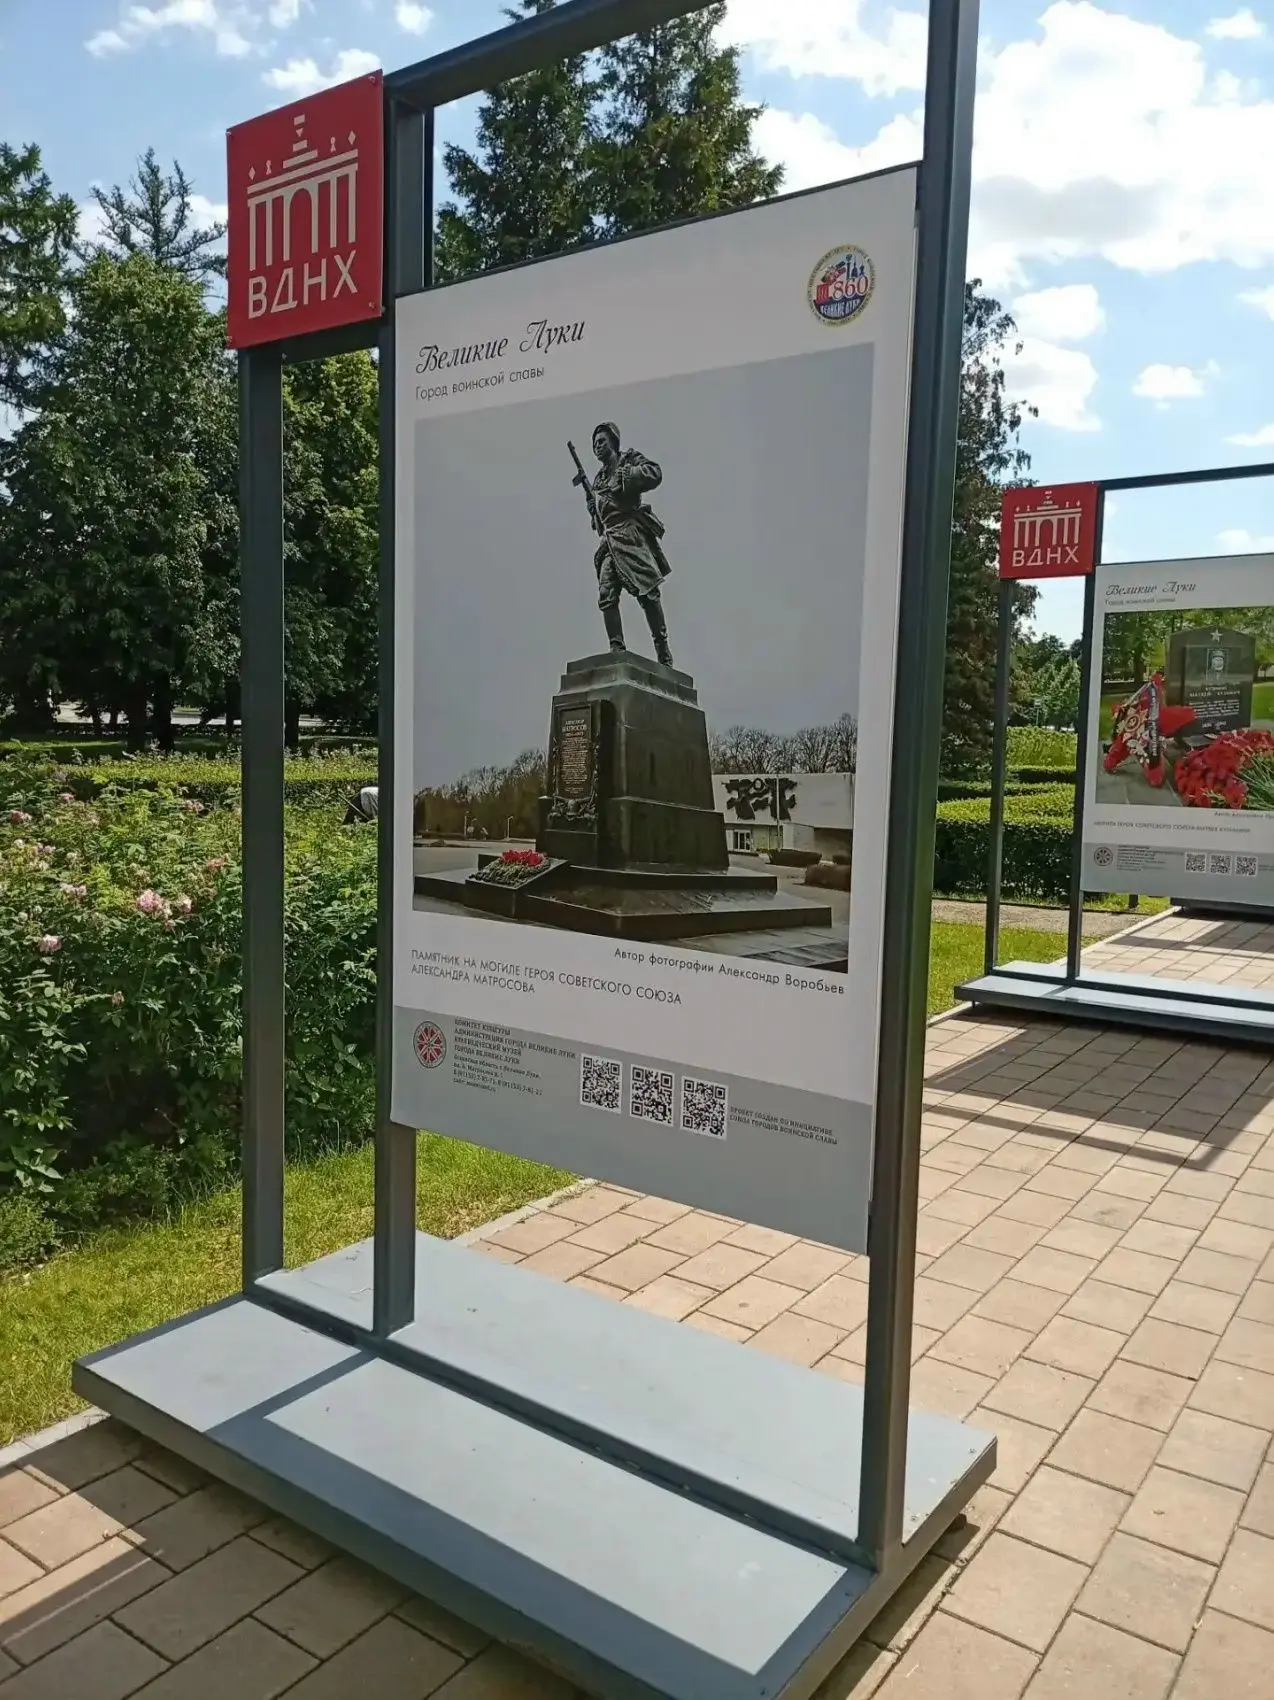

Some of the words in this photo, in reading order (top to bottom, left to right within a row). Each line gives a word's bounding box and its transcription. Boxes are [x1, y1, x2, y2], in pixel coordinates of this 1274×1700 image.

[248, 250, 358, 320] ВДНХ
[415, 337, 508, 374] Великие
[519, 319, 586, 354] Луки
[416, 384, 449, 401] Город
[452, 371, 505, 394] воинской
[509, 366, 545, 383] славы
[1012, 546, 1080, 567] ВДНХ
[1105, 584, 1158, 596] Великие
[1162, 580, 1197, 595] Луки
[411, 949, 460, 967] ПАМЯТНИК
[463, 957, 477, 969] НА
[480, 960, 521, 977] МОГИЛЕ
[524, 966, 555, 982] ГЕРОЯ
[558, 972, 632, 996] СОВЕТСКОГО
[636, 986, 682, 1005] СОЮЗА
[411, 963, 470, 983] АЛЕКСАНДРА
[473, 974, 536, 994] МАТРОСОВА
[614, 947, 645, 964] Автор
[648, 952, 714, 974] фотографии
[718, 963, 780, 986] Александр
[785, 973, 845, 995] Воробьев
